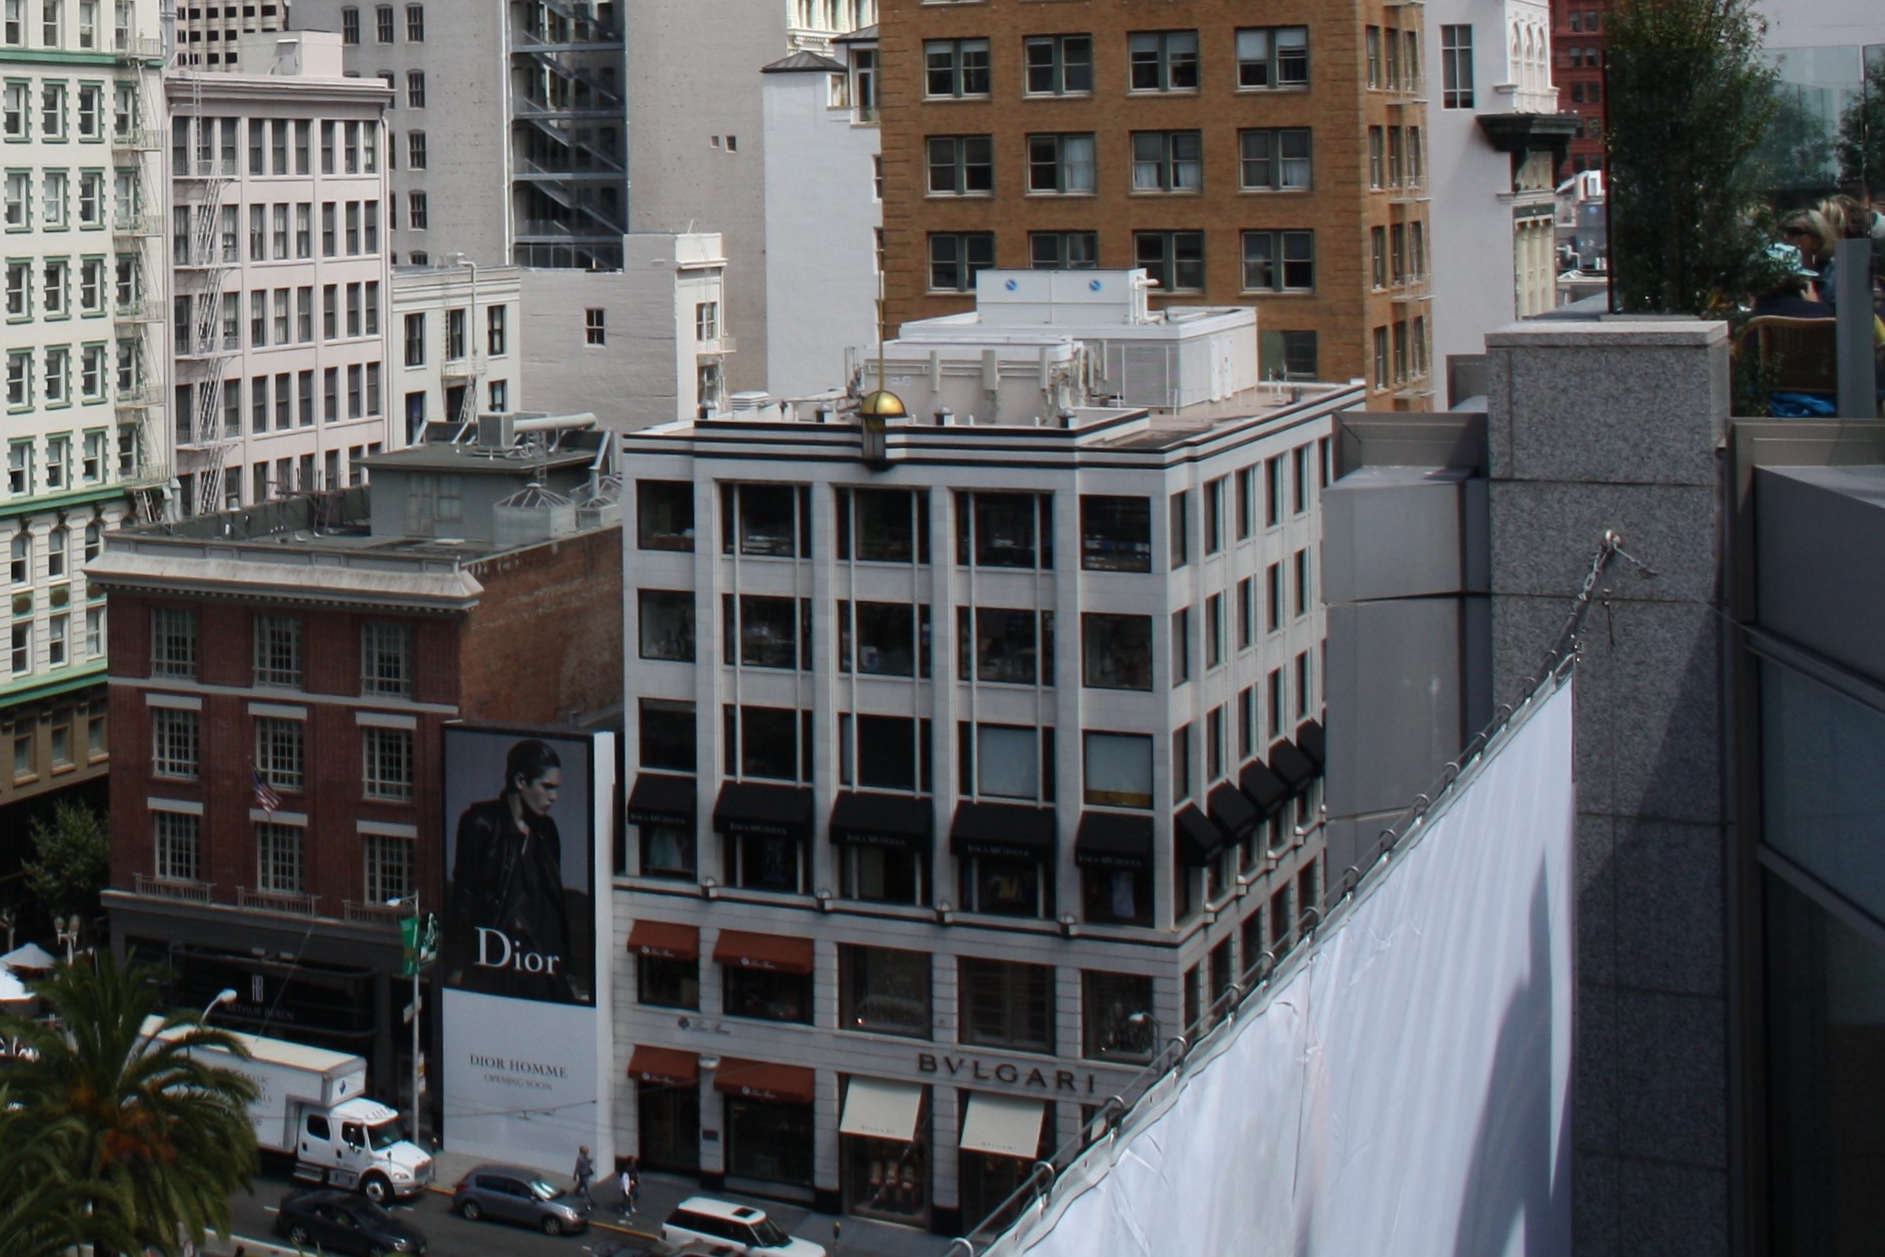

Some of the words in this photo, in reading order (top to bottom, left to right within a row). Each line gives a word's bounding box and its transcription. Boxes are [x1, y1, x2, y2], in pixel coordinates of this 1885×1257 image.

[474, 927, 560, 974] Dior
[470, 1054, 505, 1070] DIOR
[509, 1060, 568, 1078] HOMME
[918, 1053, 1096, 1094] BVLGARI
